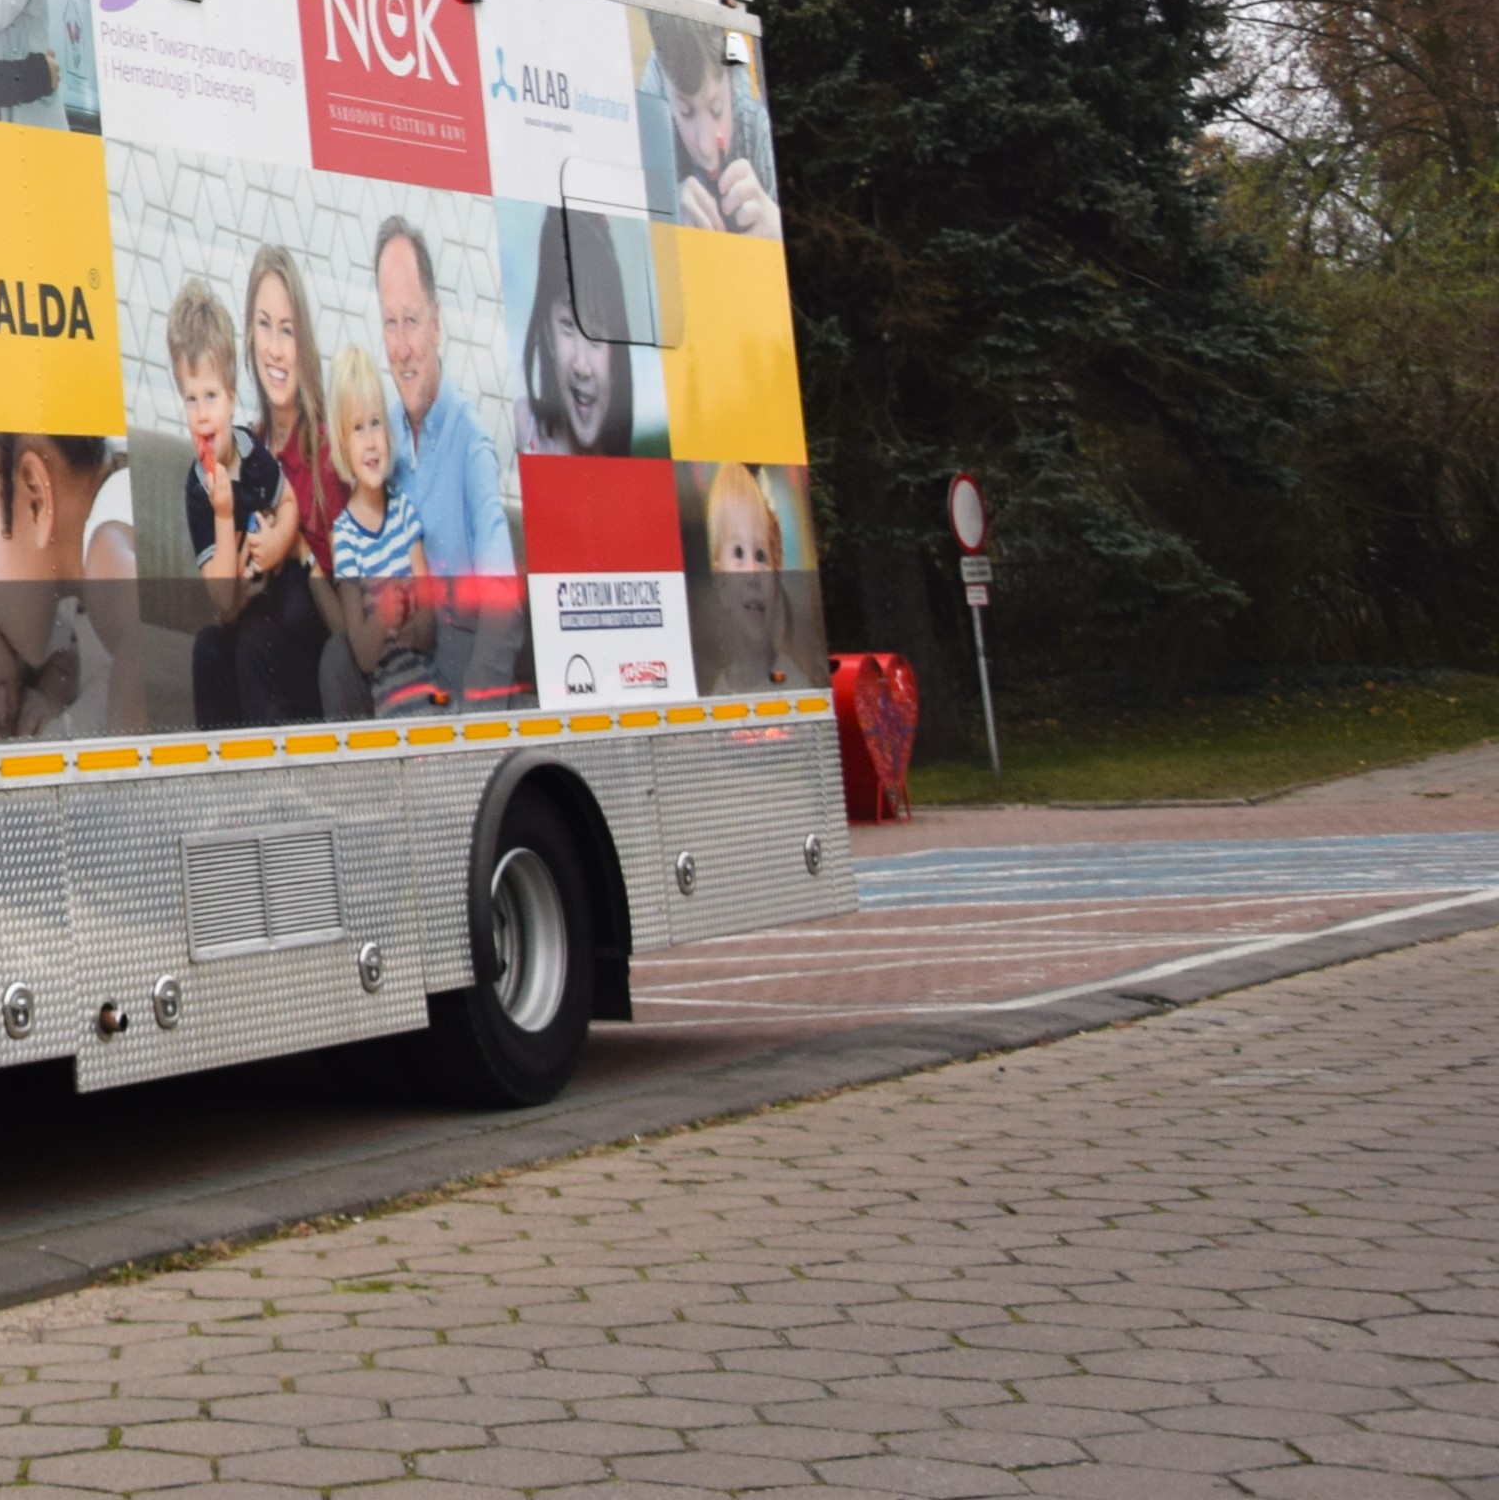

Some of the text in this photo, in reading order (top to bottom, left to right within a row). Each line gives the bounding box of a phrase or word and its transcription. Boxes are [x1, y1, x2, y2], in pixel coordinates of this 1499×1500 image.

[100, 21, 298, 85] Polskie Towarzystwo Onkologii
[111, 58, 191, 99] Hematologii
[523, 63, 570, 110] ALAB
[328, 103, 385, 128] NARODOWE
[389, 114, 437, 137] CENTRUM
[569, 580, 661, 607] CENTRUM MEDYCZNE
[567, 682, 594, 694] MAN
